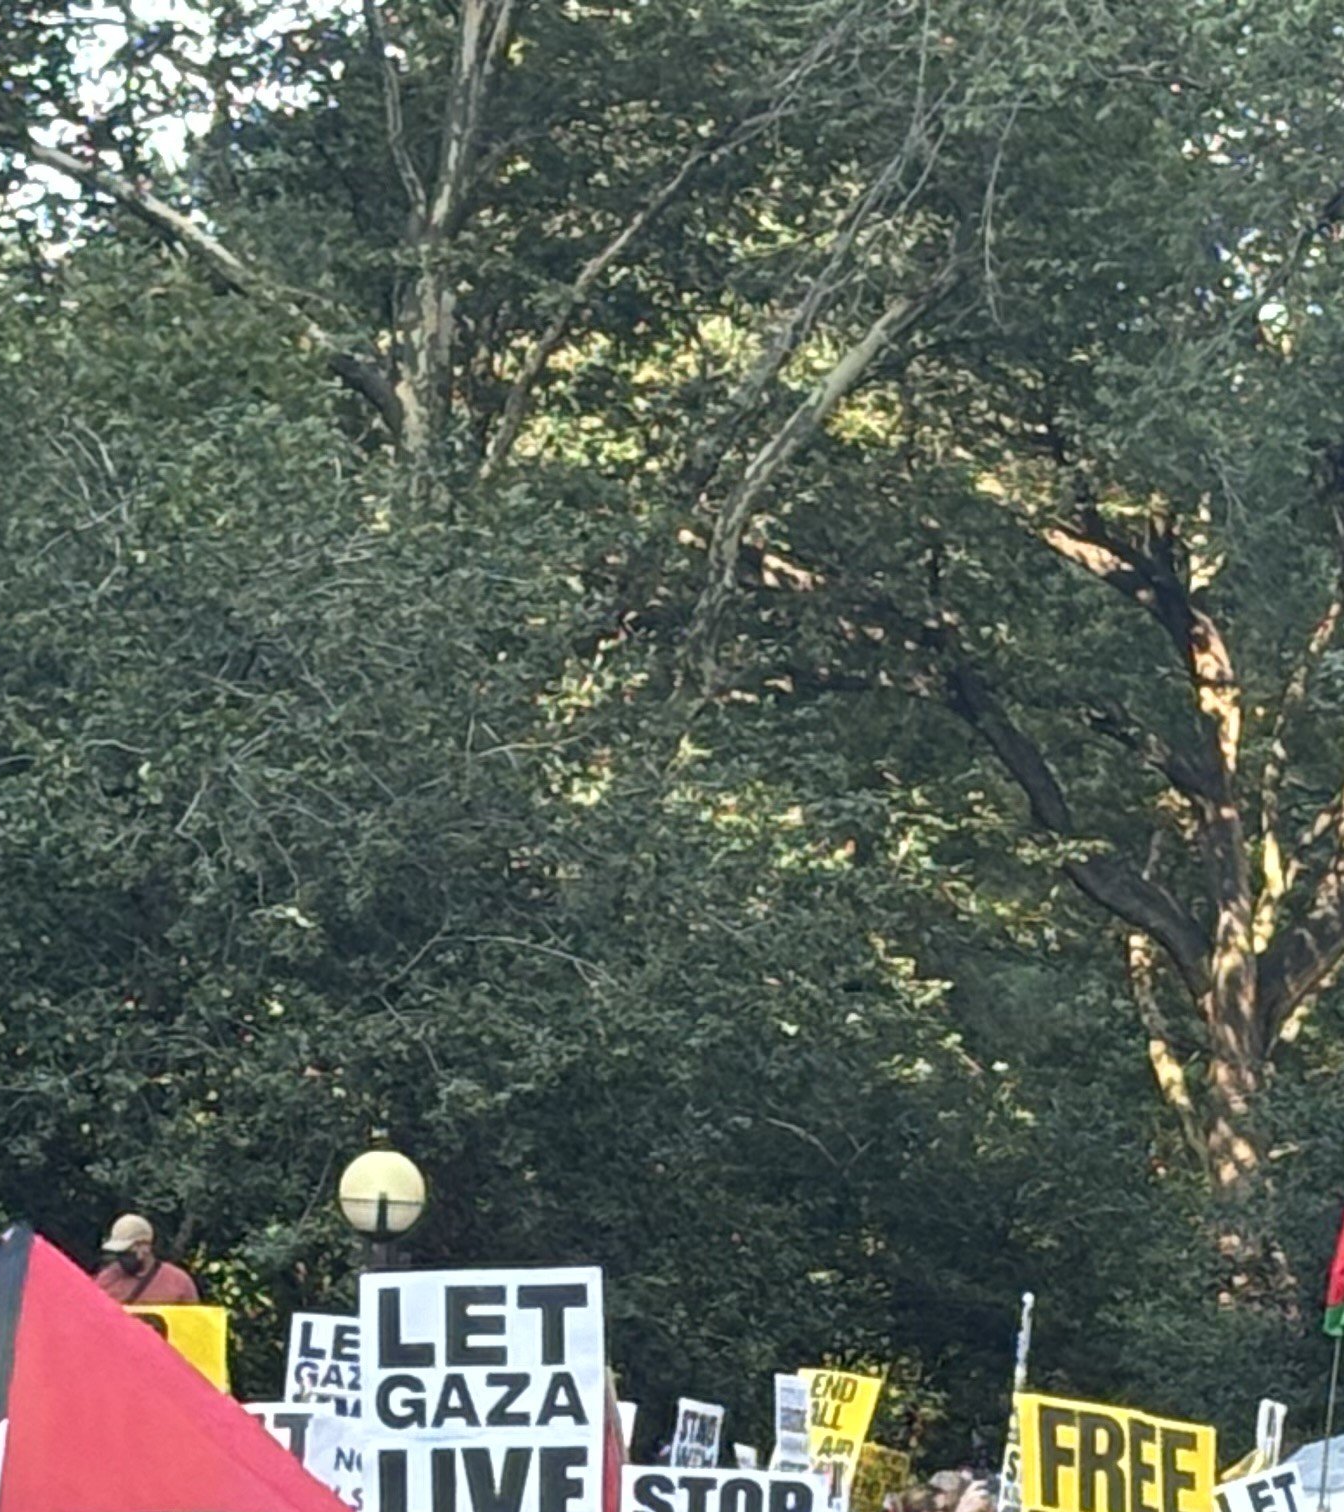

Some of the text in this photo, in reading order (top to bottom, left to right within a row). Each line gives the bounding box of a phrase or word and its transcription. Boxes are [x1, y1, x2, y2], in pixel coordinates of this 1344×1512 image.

[298, 1321, 361, 1362] LE
[378, 1284, 588, 1369] LET
[294, 1361, 362, 1391] GAZ
[811, 1373, 858, 1404] END
[376, 1372, 589, 1430] GAZA
